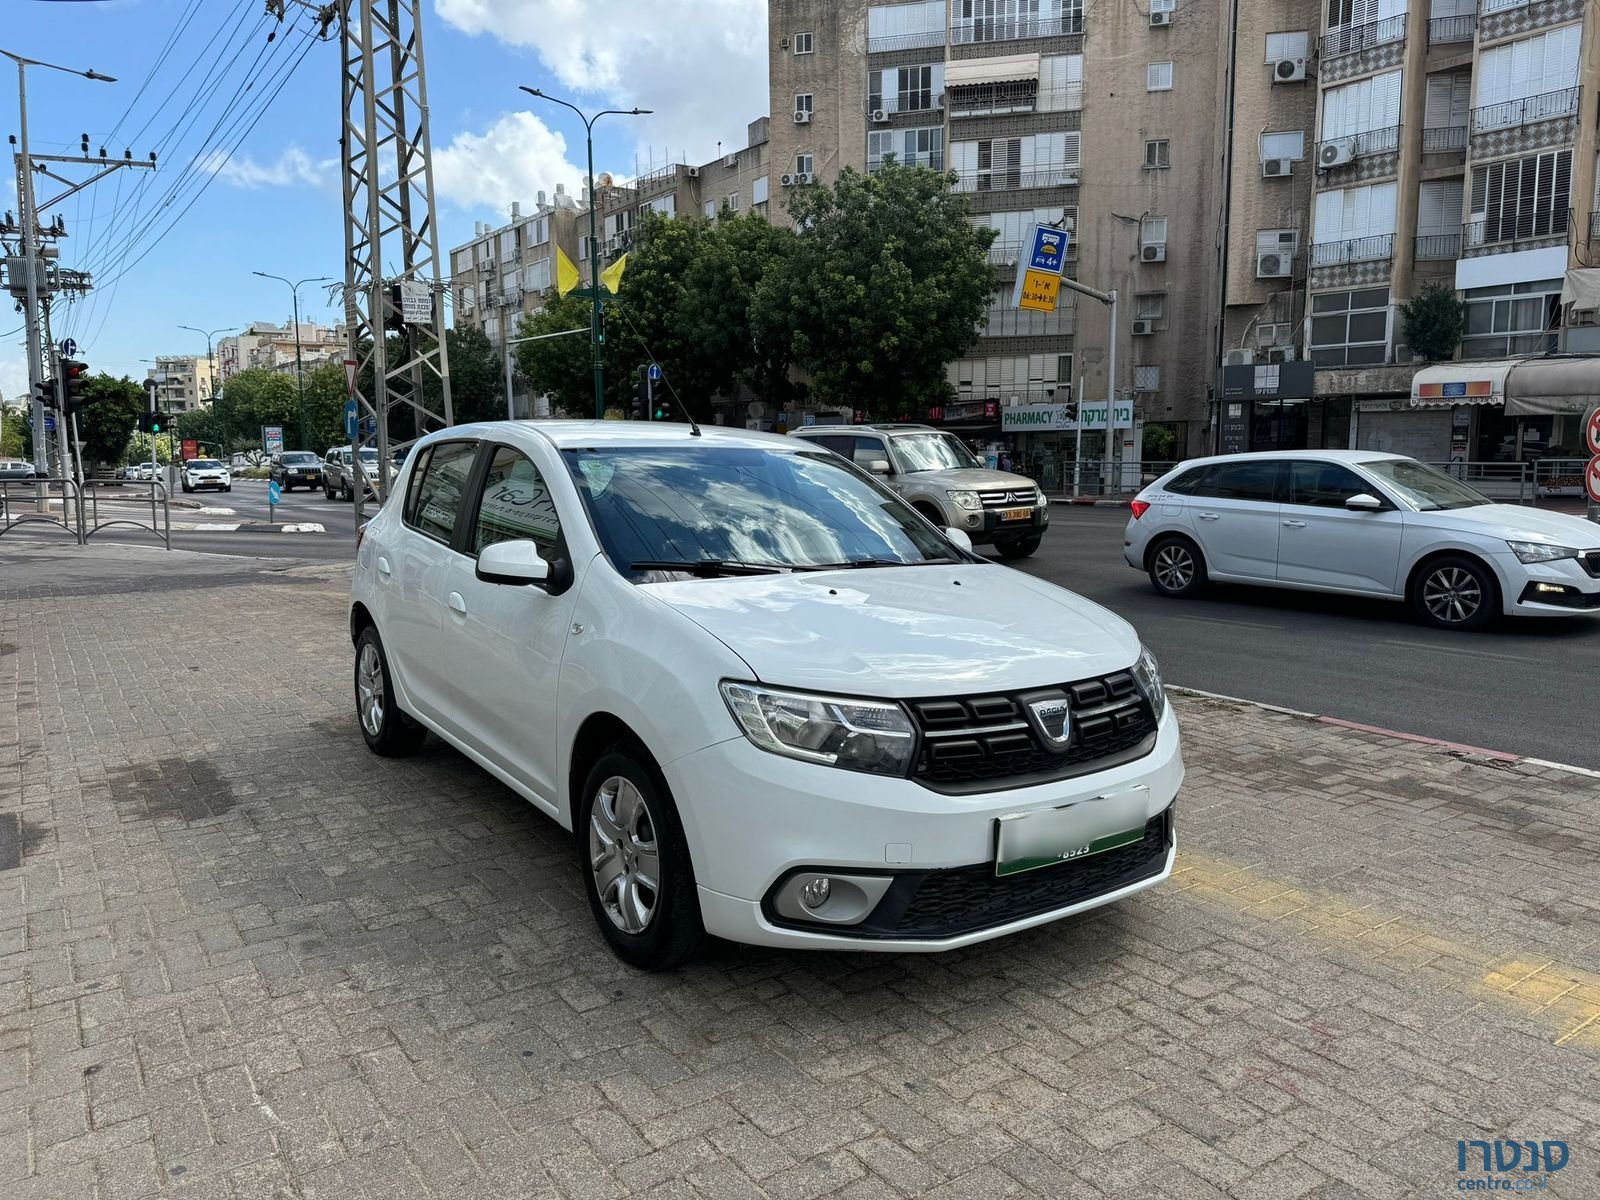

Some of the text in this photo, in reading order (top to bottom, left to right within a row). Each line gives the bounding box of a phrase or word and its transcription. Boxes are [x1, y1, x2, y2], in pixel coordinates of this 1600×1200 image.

[1046, 257, 1058, 266] 4+
[1004, 410, 1053, 425] PHARMACY
[1039, 705, 1067, 717] DACIA
